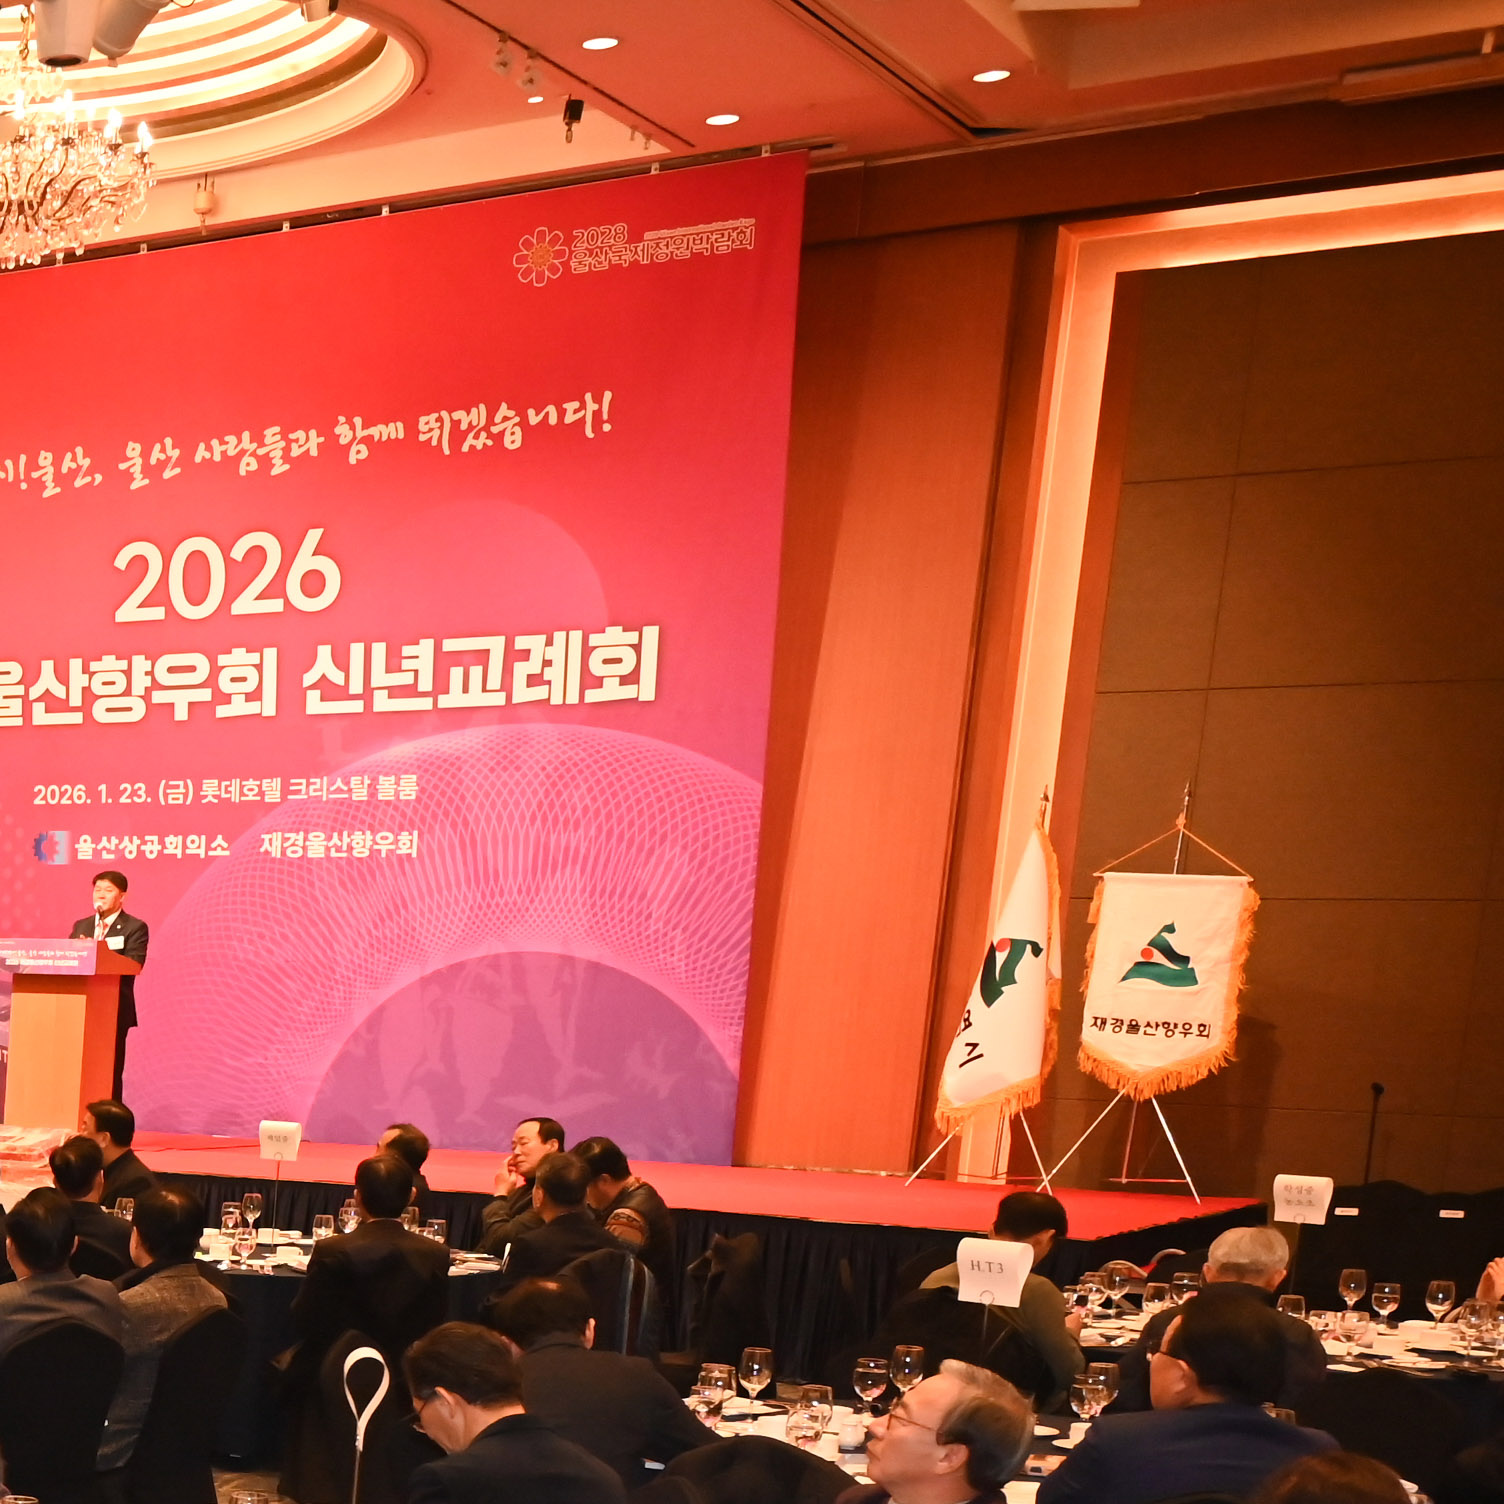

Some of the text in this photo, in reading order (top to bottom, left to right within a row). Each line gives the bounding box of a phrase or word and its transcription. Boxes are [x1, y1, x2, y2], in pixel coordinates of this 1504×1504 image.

[570, 225, 756, 274] 울산국제정원박람회
[572, 223, 629, 250] 2028
[118, 436, 182, 491] 울산
[194, 425, 325, 477] 사람들과
[333, 416, 406, 465] 함께
[417, 390, 613, 457] 뛰겠습니다!
[112, 526, 342, 624] 2026
[301, 624, 661, 716] 신년교례회
[32, 774, 419, 806] 2026. 1. 23. (금) 롯데호텔 크리스탈 볼룸
[74, 829, 420, 860] 울산상공회의소 재경울산향우회
[1088, 1014, 1212, 1040] 재경울산향우회
